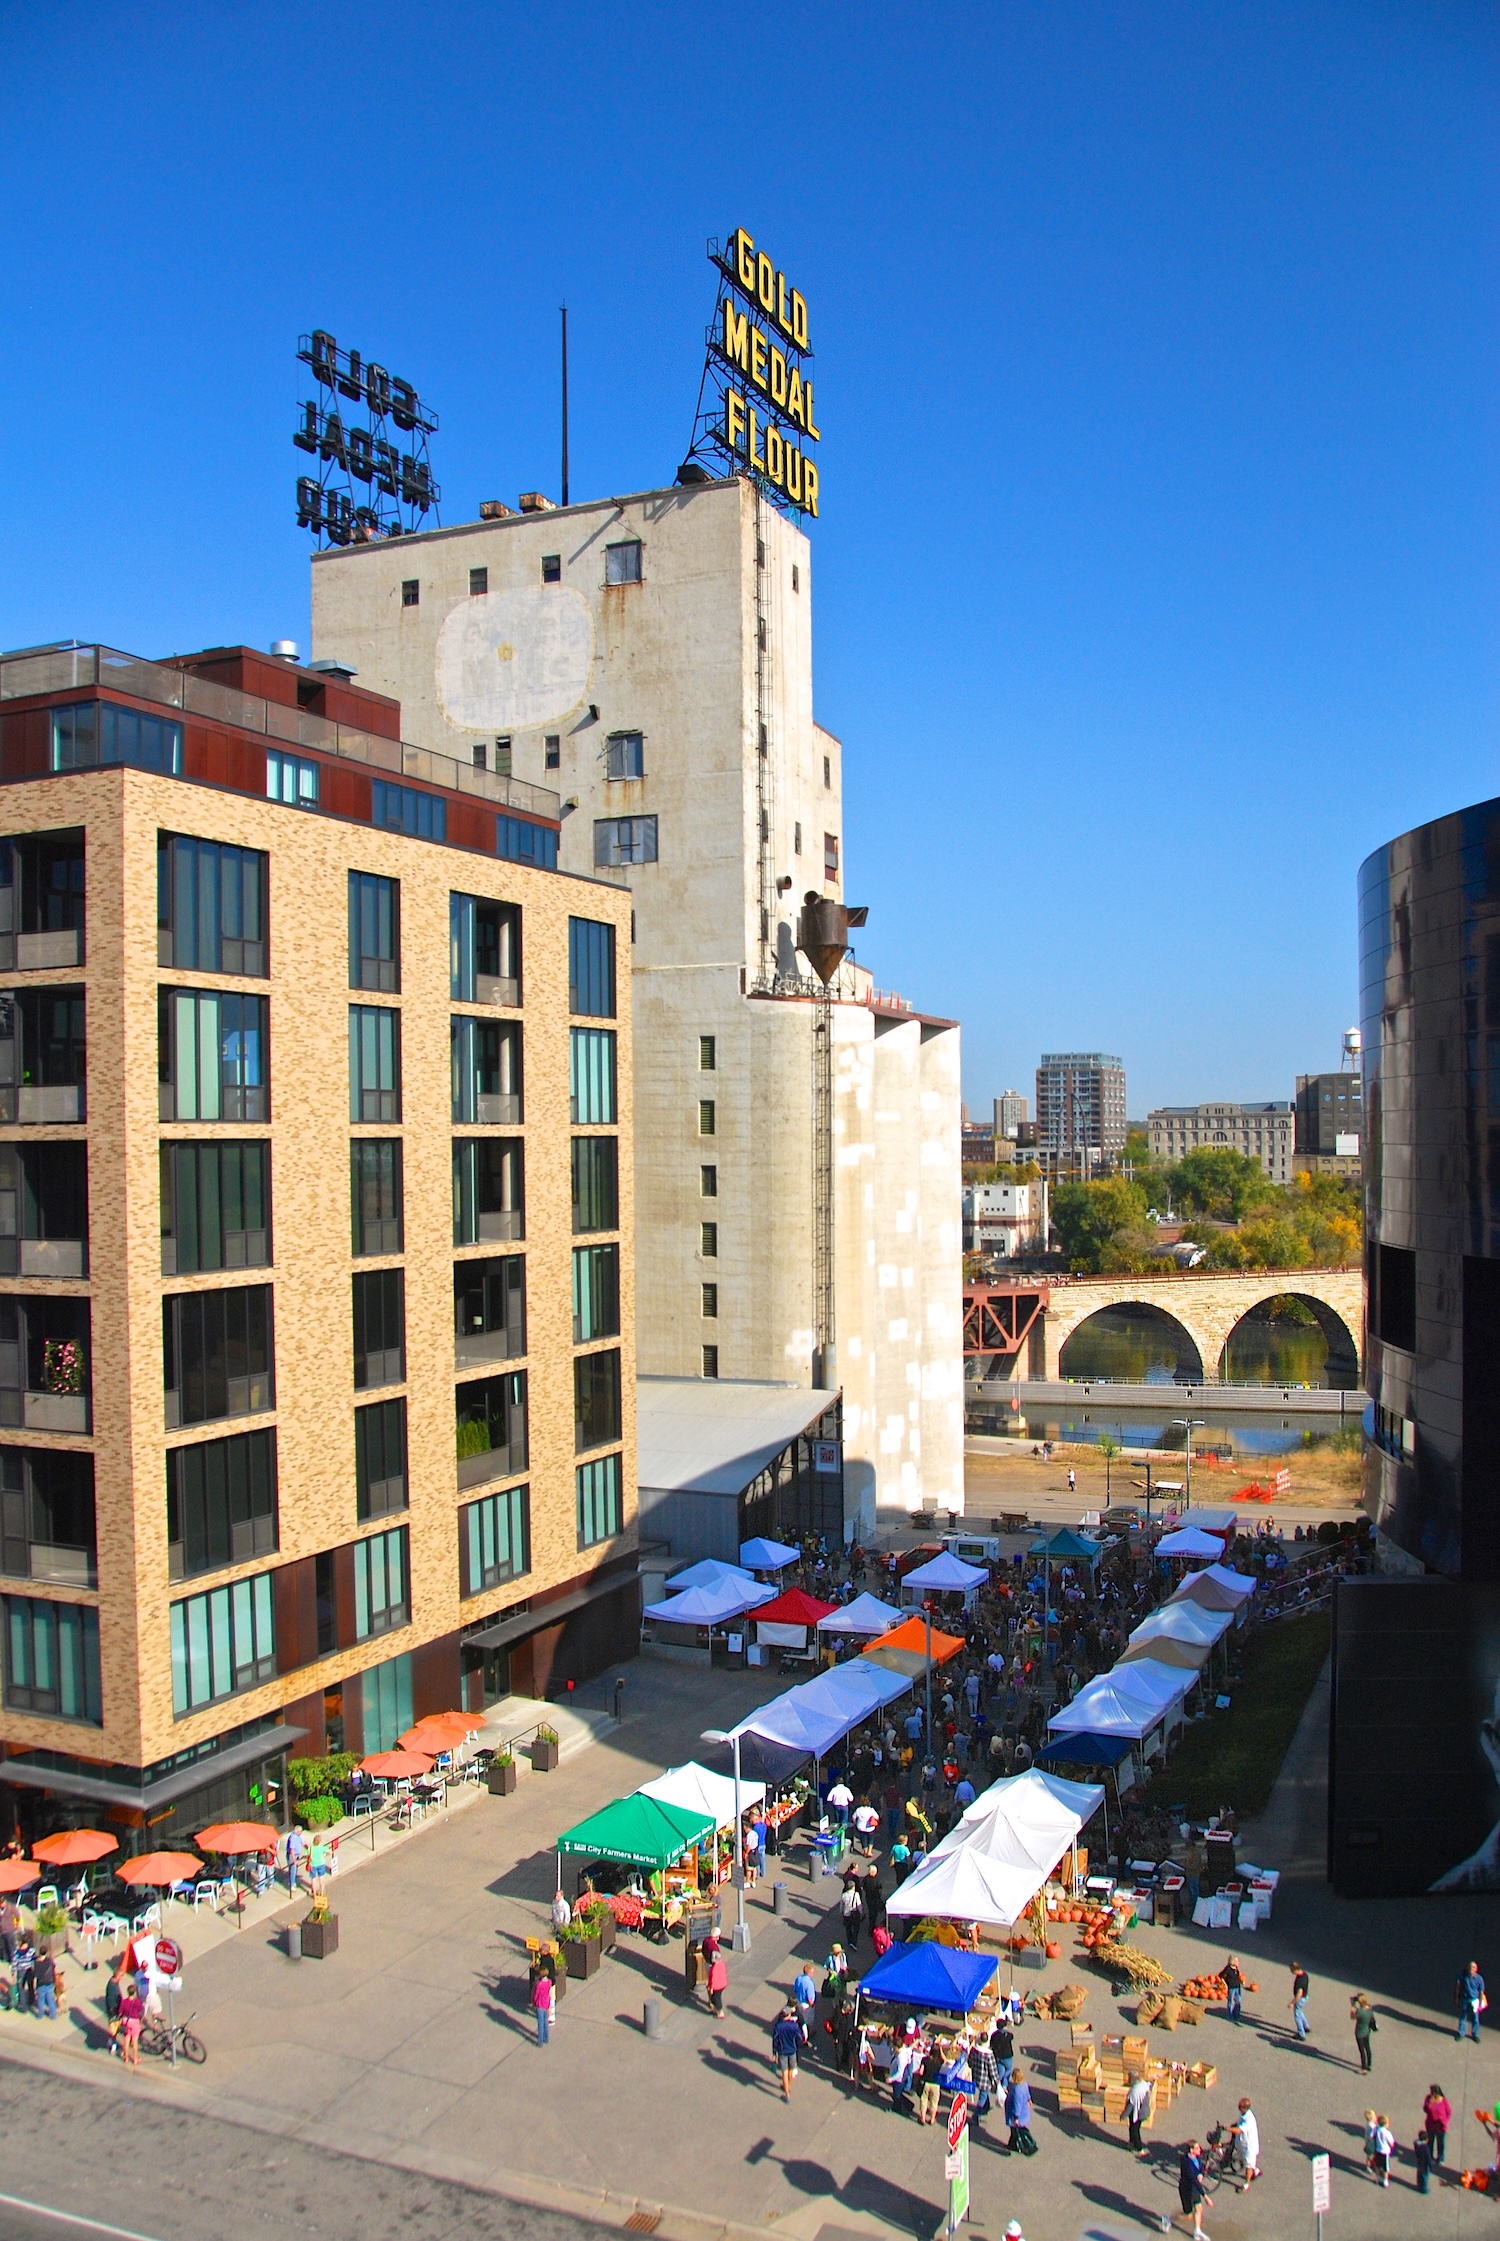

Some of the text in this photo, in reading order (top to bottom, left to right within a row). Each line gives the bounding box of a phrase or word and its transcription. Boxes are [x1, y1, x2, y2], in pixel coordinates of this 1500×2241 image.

[736, 227, 808, 349] GOLD
[724, 298, 820, 441] MEDAL
[726, 387, 818, 517] FLOUR
[701, 1822, 714, 1836] Market
[573, 1842, 658, 1865] Mill City Farmers Market
[964, 2083, 974, 2092] St
[949, 2101, 967, 2138] STOP
